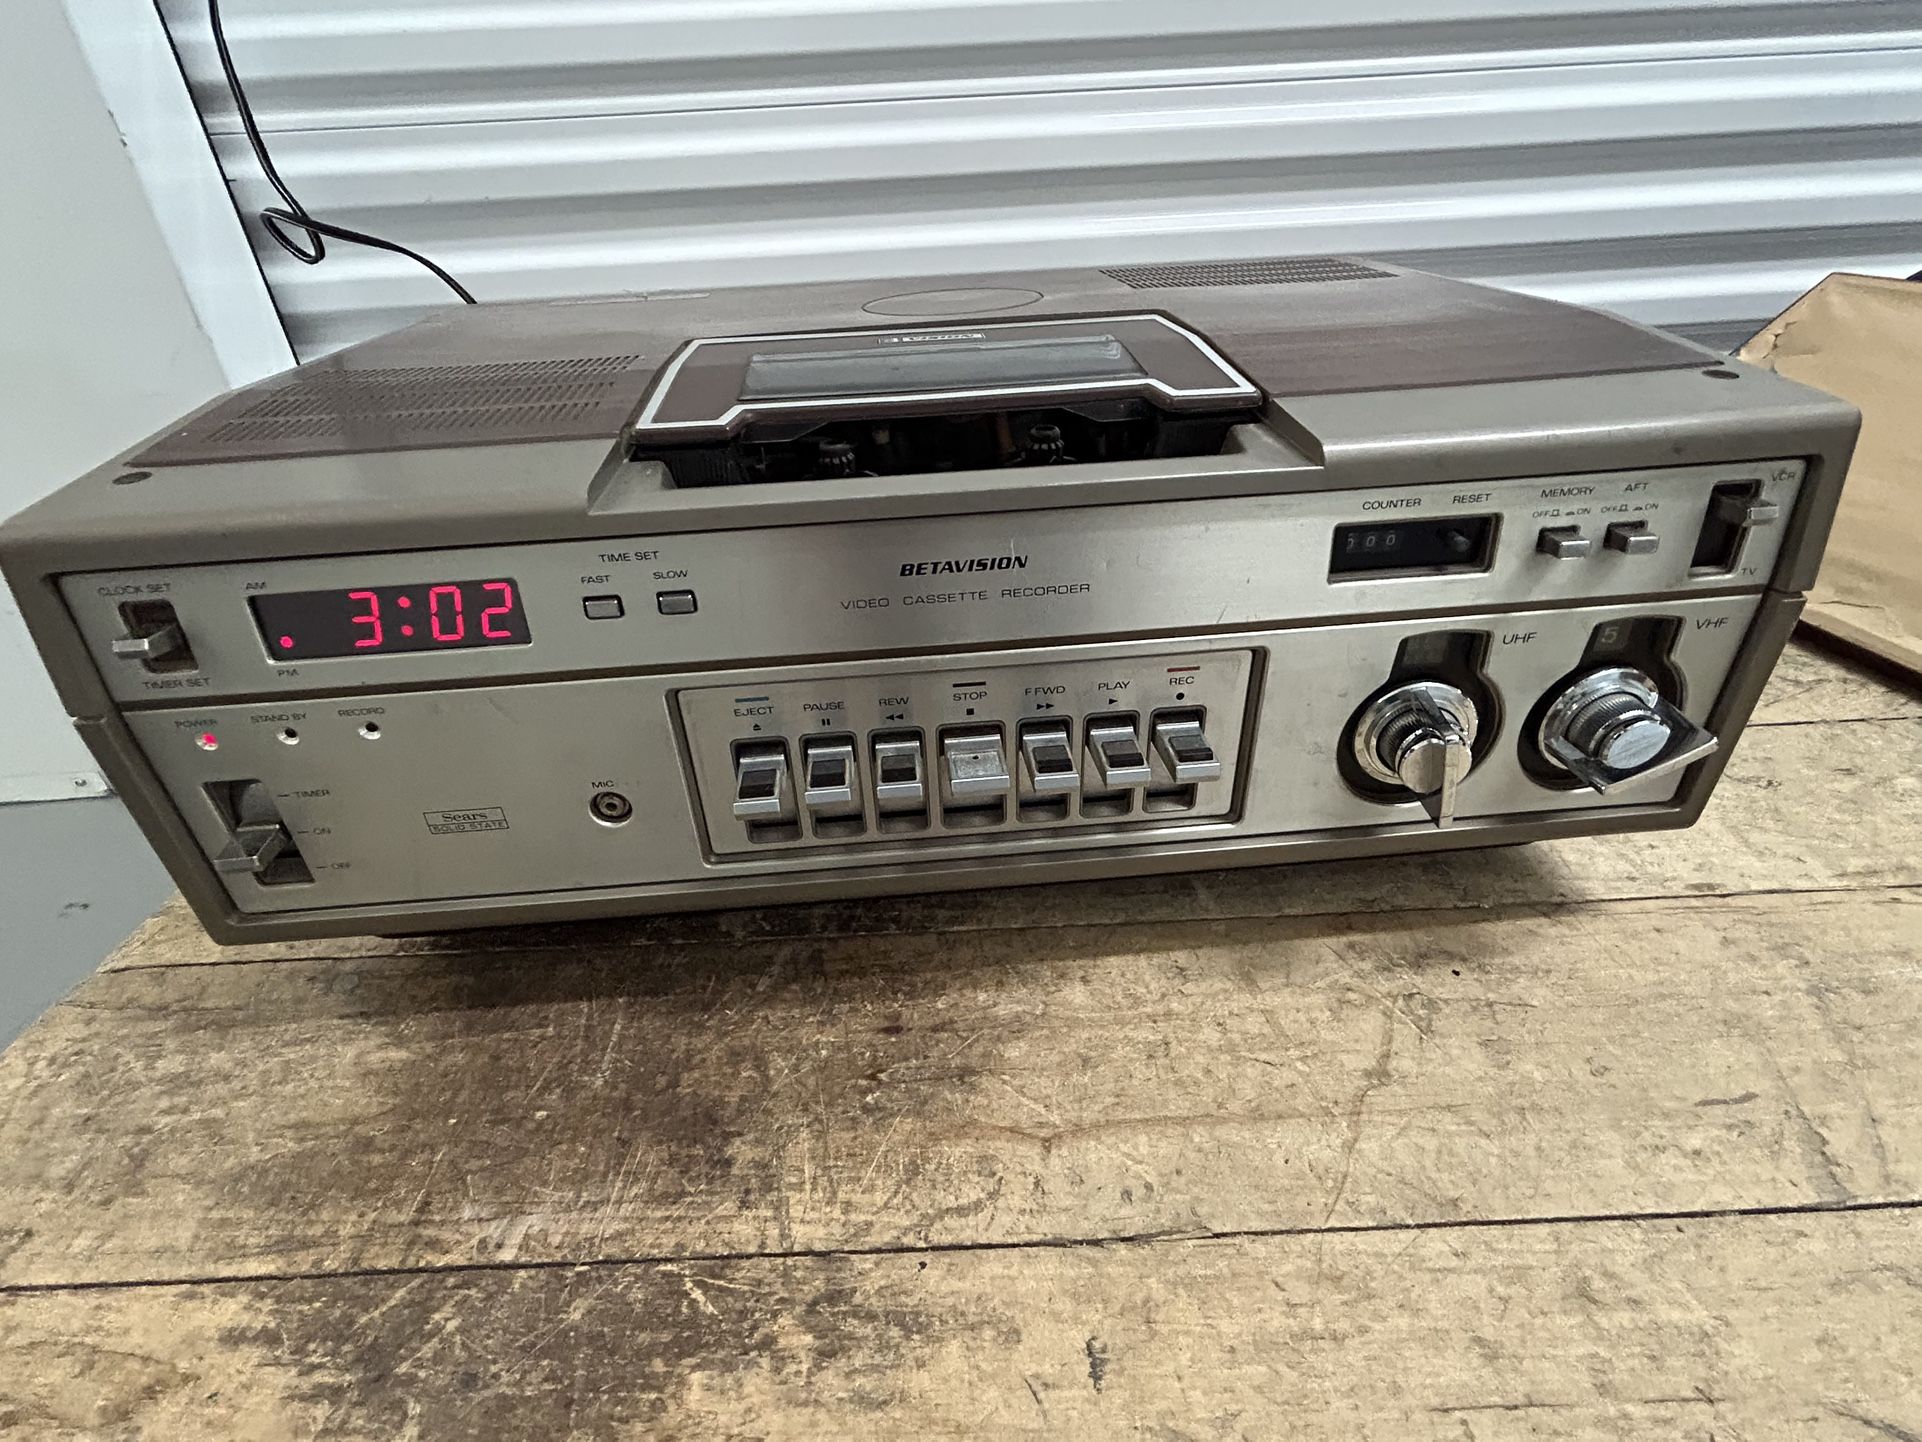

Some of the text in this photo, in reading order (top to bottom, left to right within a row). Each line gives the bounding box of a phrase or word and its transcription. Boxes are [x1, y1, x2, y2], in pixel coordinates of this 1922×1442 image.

[1771, 471, 1796, 482] VCR
[1540, 486, 1596, 498] MEMORY
[1624, 482, 1649, 493] AFT
[1362, 498, 1422, 510] COUNTER
[1452, 493, 1492, 504] RESET
[1577, 507, 1592, 515] ON
[1601, 505, 1618, 513] OFF
[1644, 502, 1659, 511] ON
[1532, 510, 1550, 518] OFF
[599, 550, 660, 563] TIME SET
[900, 555, 1028, 577] BETAVISION
[1741, 567, 1758, 575] TV
[581, 575, 611, 584] FAST
[653, 570, 689, 580] SLOW
[97, 582, 171, 597] CLOCK SET
[245, 581, 267, 590] AM
[841, 583, 1091, 610] VIDEO CASSETTE RECORDER
[348, 582, 513, 648] 3:02
[1696, 617, 1729, 630] VHF
[1502, 632, 1538, 645] UHF
[1601, 626, 1619, 644] 5
[278, 669, 299, 677] PM
[142, 677, 210, 690] TIMER SET
[1098, 680, 1131, 691] PLAY
[1169, 676, 1195, 686] REC
[878, 696, 910, 707] REW
[952, 691, 988, 701] STOP
[338, 707, 385, 717] RECORD
[733, 706, 774, 717] EJECT
[803, 701, 845, 712] PAUSE
[174, 718, 218, 728] POWER
[251, 712, 307, 724] STAND BY
[591, 779, 615, 789] MIC
[292, 789, 330, 798] TIMER
[441, 811, 489, 823] Sears
[313, 827, 331, 836] ON
[432, 820, 506, 833] SOLID STATE
[331, 862, 351, 870] OFF
